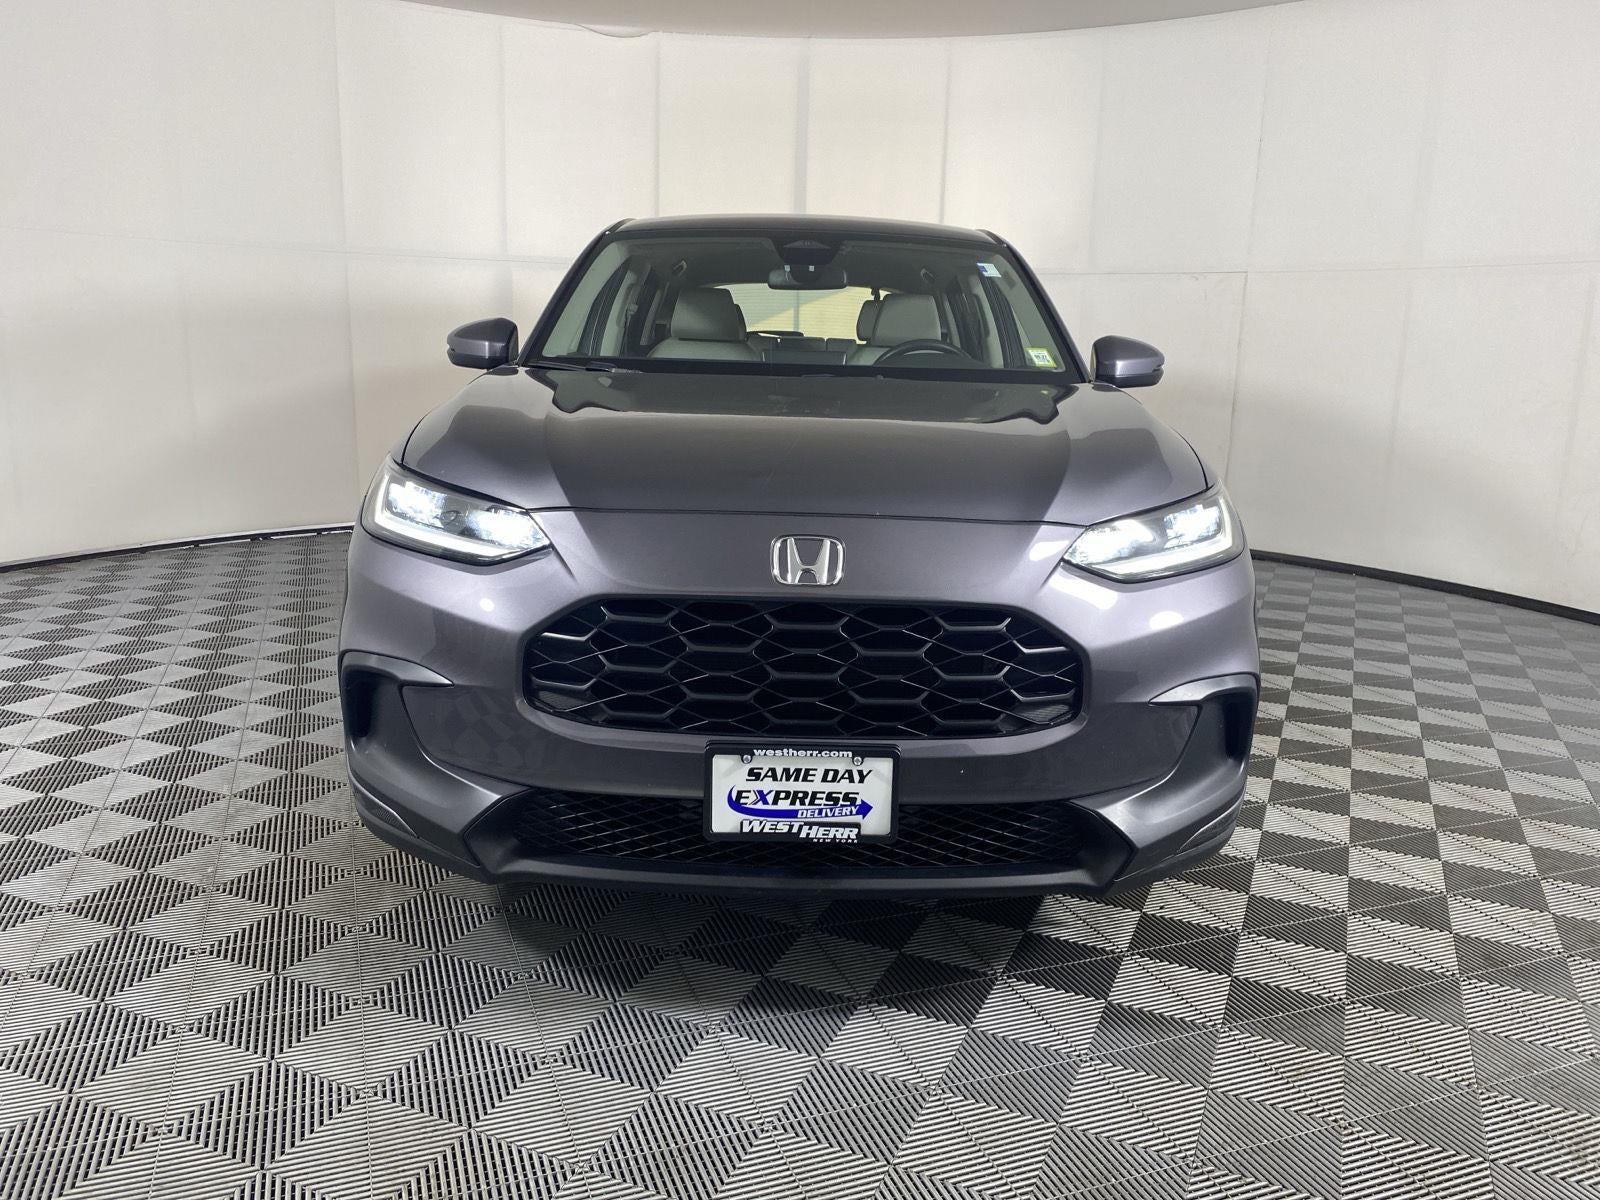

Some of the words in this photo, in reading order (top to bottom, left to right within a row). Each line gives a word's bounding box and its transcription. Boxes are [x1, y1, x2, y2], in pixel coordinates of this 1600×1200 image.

[753, 748, 853, 758] westherr.com
[746, 767, 817, 783] SAME
[821, 768, 872, 784] DAY
[734, 789, 860, 807] EXPRESS
[797, 806, 859, 818] DELIVERY
